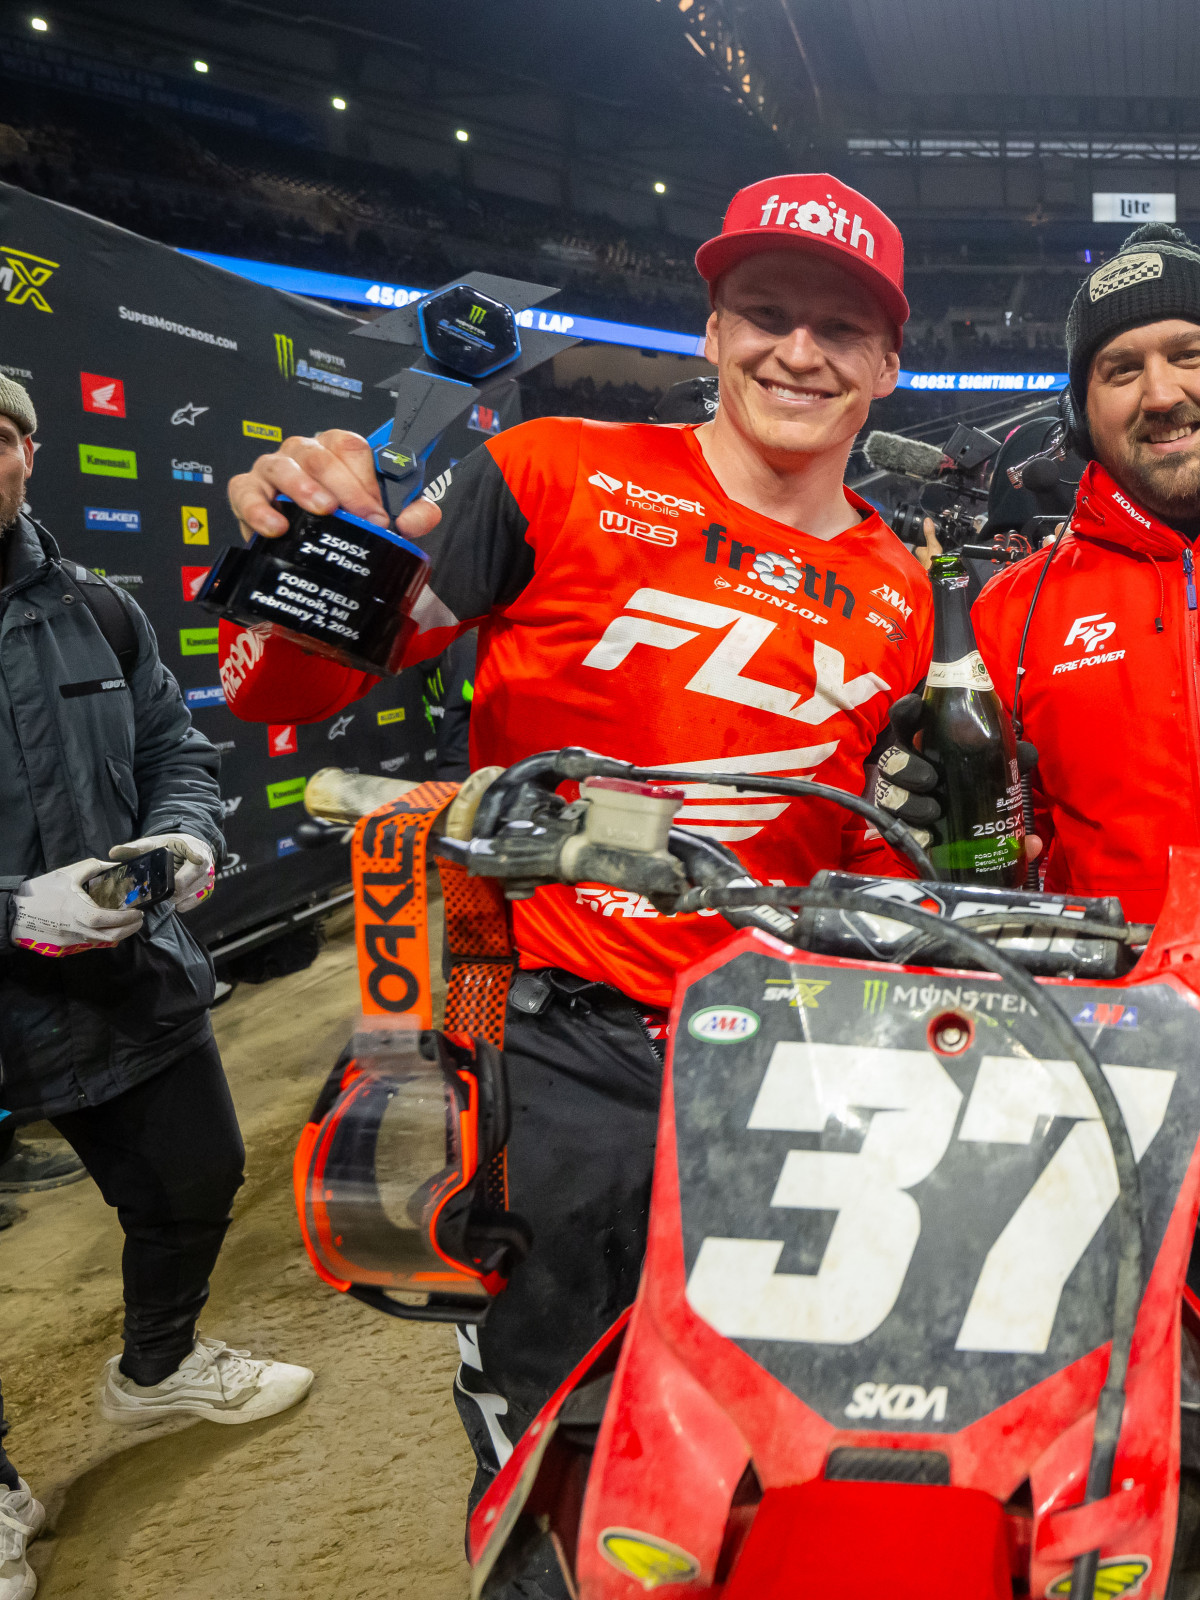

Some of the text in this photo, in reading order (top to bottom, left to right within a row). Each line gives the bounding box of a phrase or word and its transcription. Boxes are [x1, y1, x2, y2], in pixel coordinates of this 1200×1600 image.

[1120, 199, 1151, 218] Lite
[760, 194, 875, 260] froth
[365, 284, 428, 307] 450S
[538, 310, 575, 333] LAP
[910, 375, 1055, 389] 450SX SIGHTING LAP
[246, 424, 280, 439] SUZUKI
[86, 455, 130, 470] Kawasaki
[171, 458, 213, 474] GoPro
[625, 498, 680, 518] mobile
[626, 481, 706, 517] boost
[1111, 490, 1152, 530] HONDA
[88, 510, 138, 523] FALKEN
[599, 509, 678, 547] WPS
[300, 541, 371, 577] 2nd Place
[318, 533, 371, 560] 250SX
[702, 522, 857, 620] froth
[275, 585, 350, 621] Detroit, MI
[277, 571, 360, 611] FORD FIELD
[733, 583, 829, 625] DUNLOP
[869, 583, 914, 622] AMA
[250, 590, 312, 624] February
[326, 620, 361, 641] 2024
[581, 587, 893, 725] FLY
[1052, 649, 1126, 675] FIRE POWER
[101, 677, 125, 690] 100%
[972, 812, 1021, 837] 250SX
[993, 848, 1009, 856] FIELD
[701, 1015, 748, 1033] AMA
[1073, 1003, 1138, 1028] AMA
[686, 1041, 1177, 1353] 37
[844, 1382, 949, 1421] SKDA
